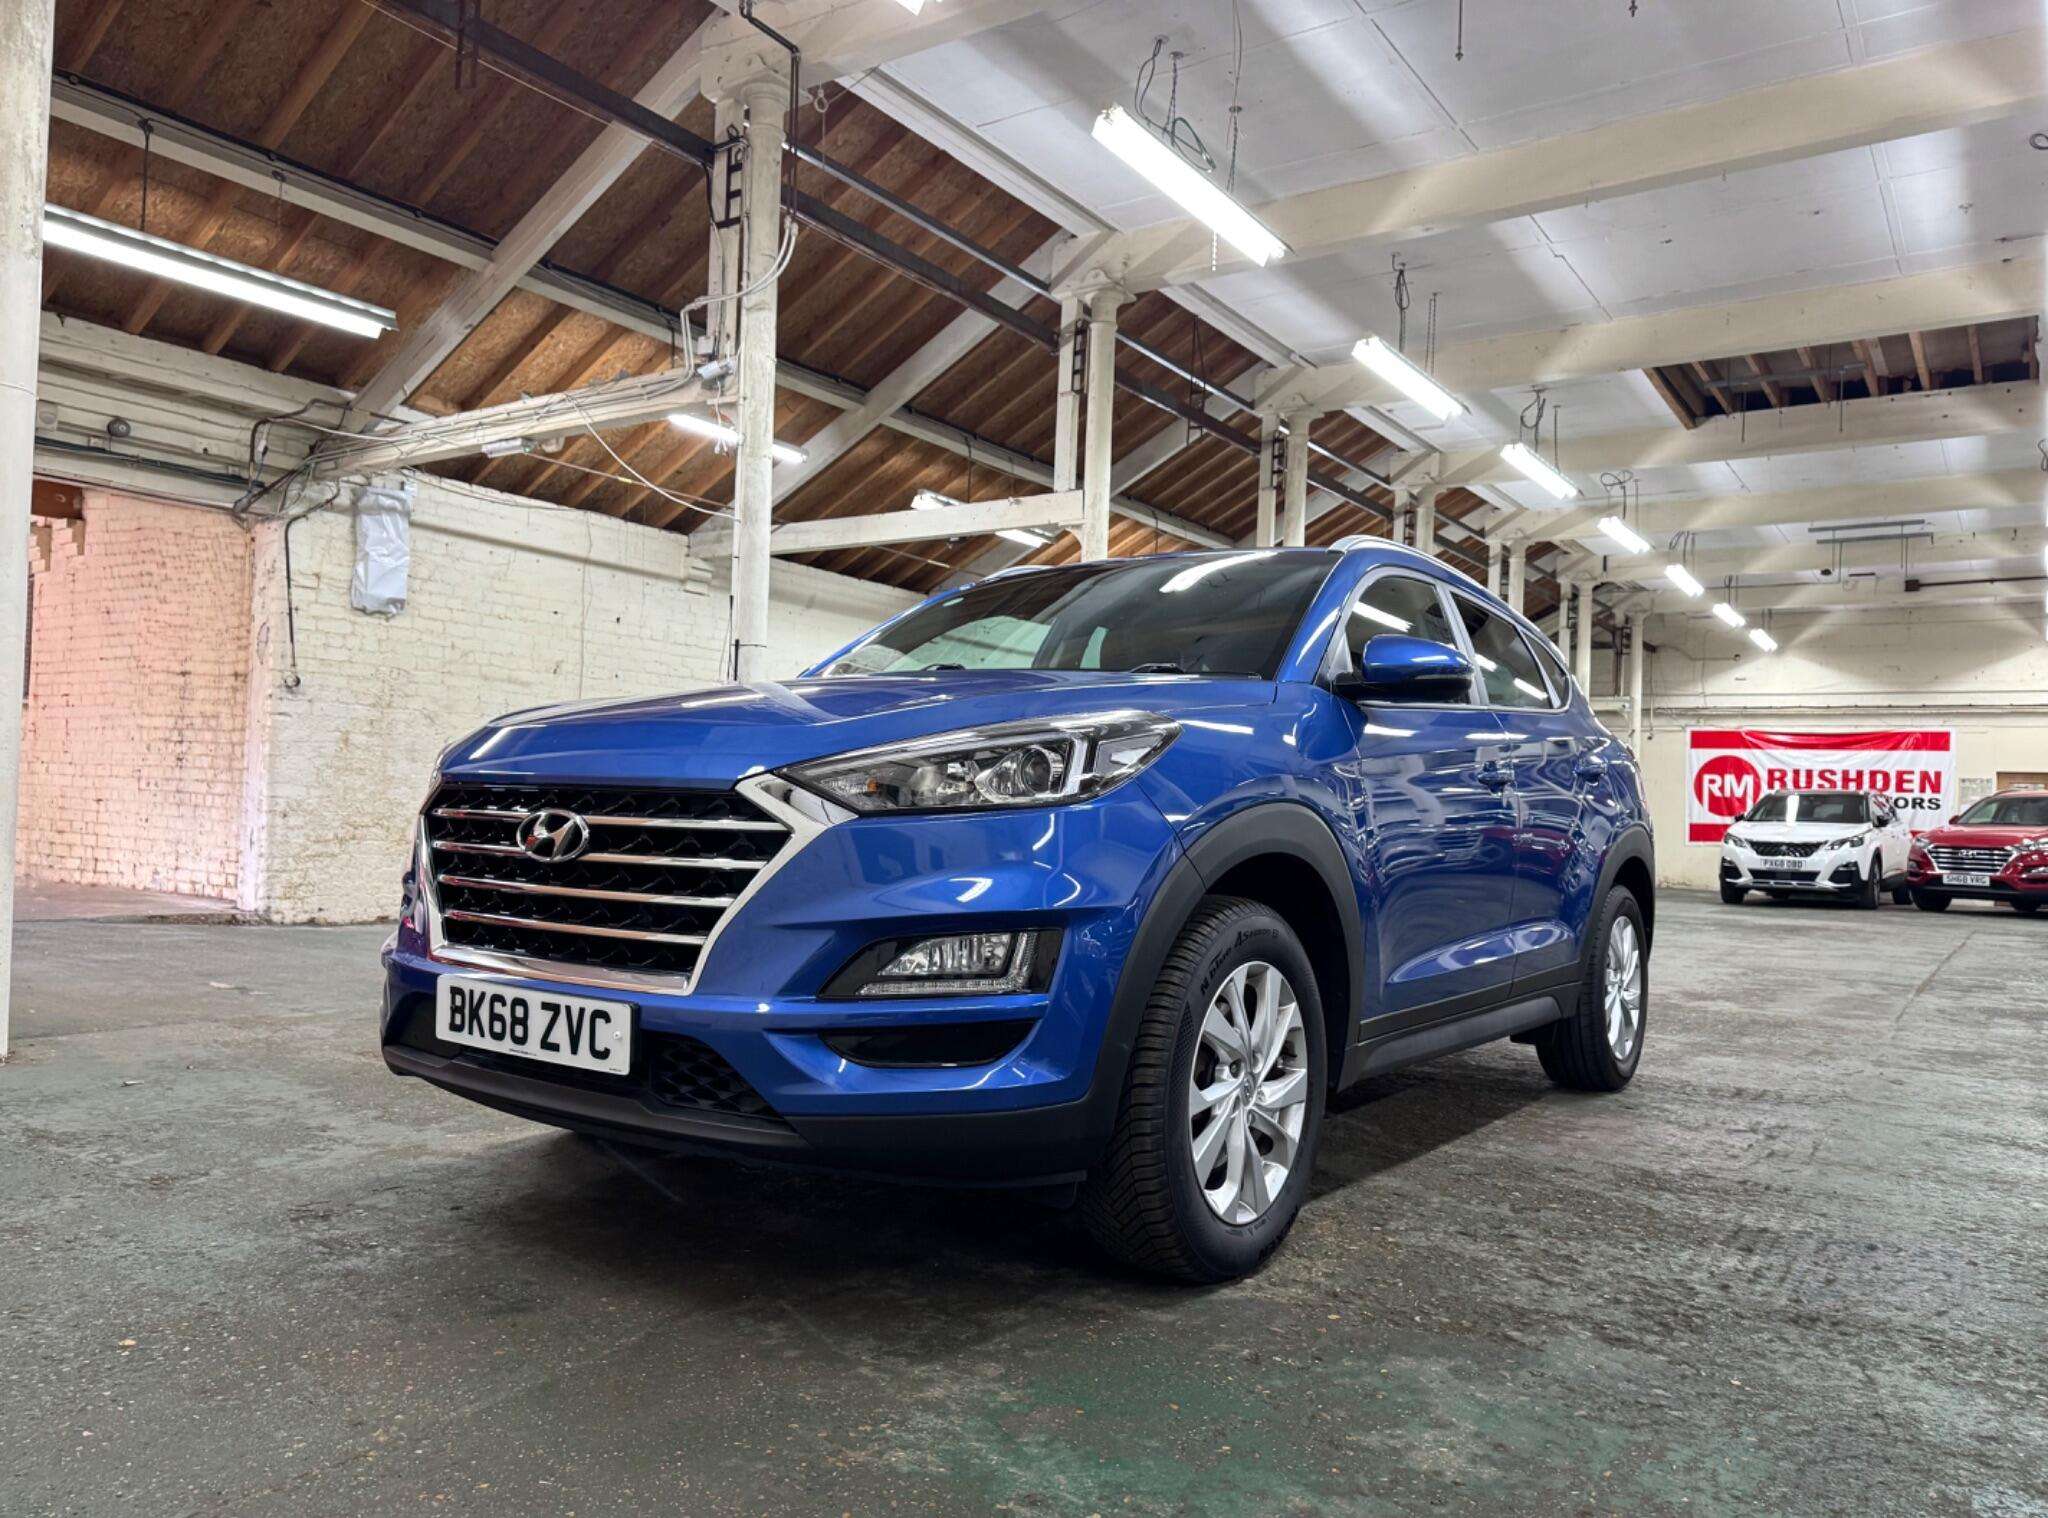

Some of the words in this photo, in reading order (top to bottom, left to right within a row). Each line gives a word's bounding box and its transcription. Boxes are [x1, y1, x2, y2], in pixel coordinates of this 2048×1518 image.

[1703, 773, 1753, 810] RM
[1767, 768, 1942, 794] RUSHDEN
[1893, 796, 1941, 811] ORS
[449, 986, 529, 1046] BK68
[540, 1001, 612, 1061] ZVC
